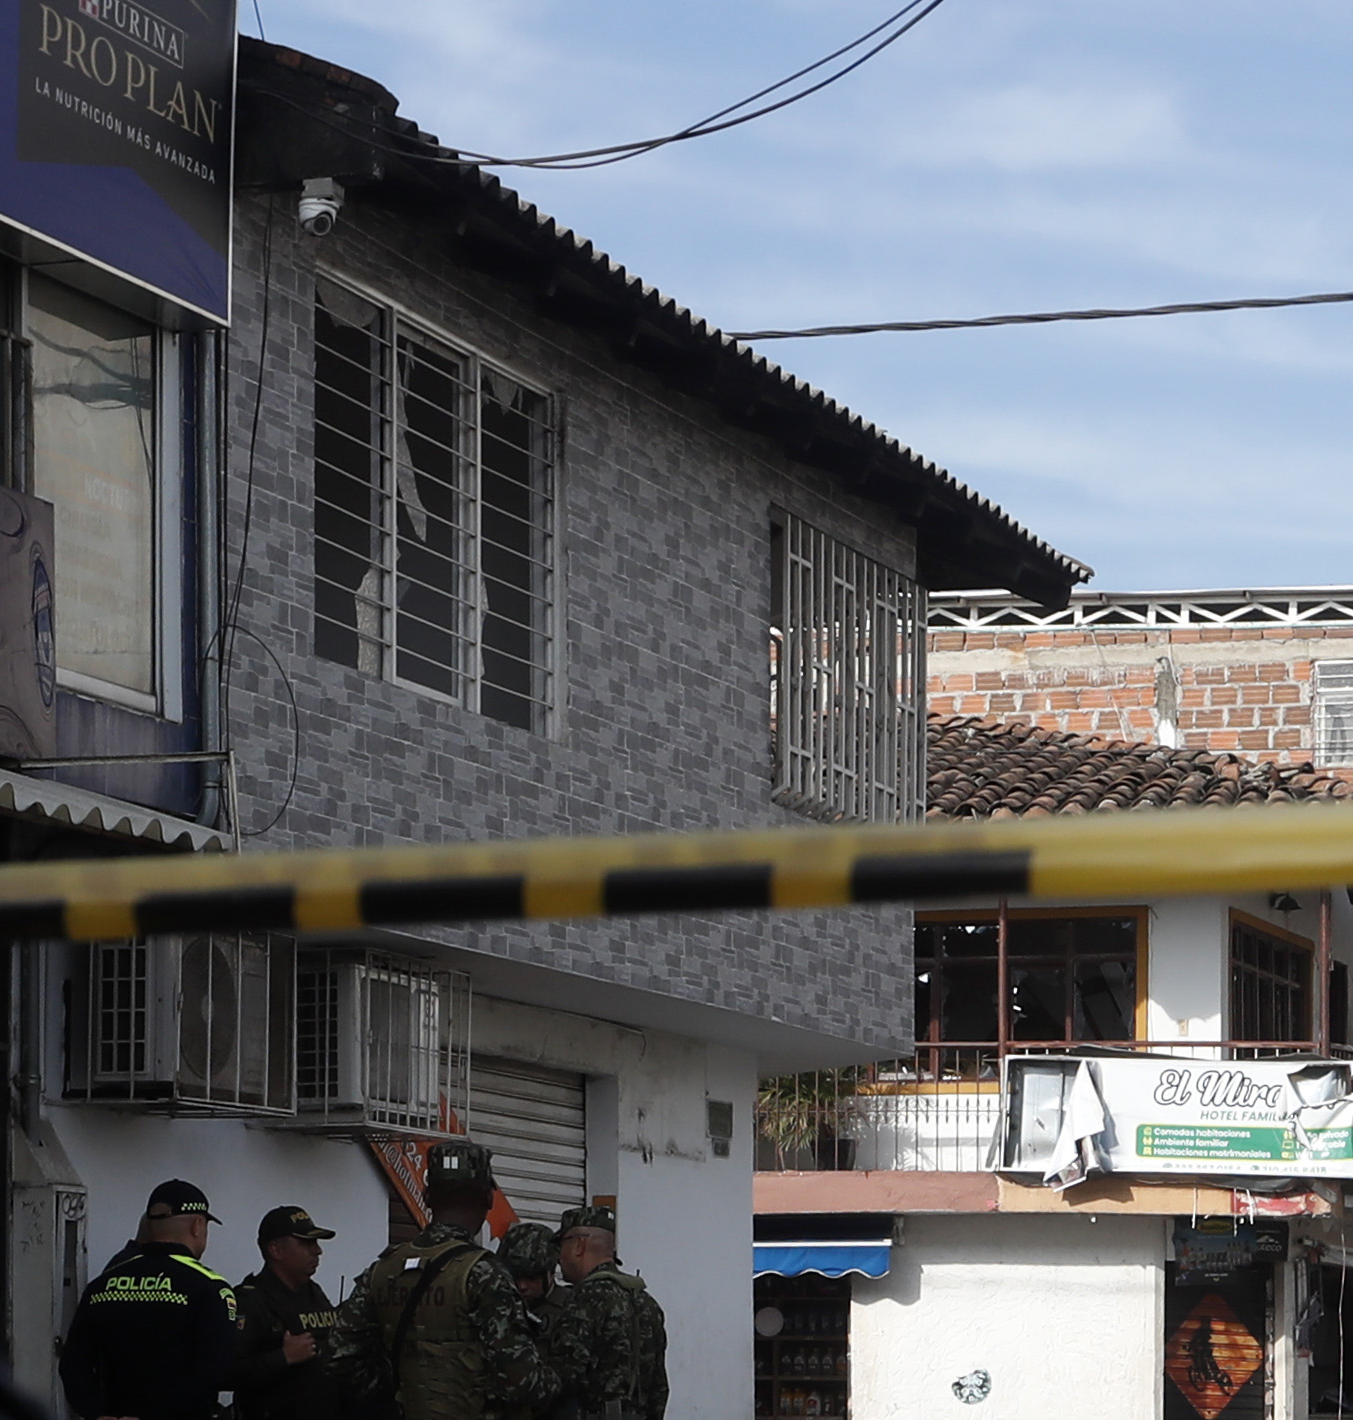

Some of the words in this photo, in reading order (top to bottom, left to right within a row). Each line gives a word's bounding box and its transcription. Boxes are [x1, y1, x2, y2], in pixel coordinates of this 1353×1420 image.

[103, 0, 181, 61] PURINA
[38, 3, 117, 87] PRO
[123, 51, 218, 144] PLAN
[34, 77, 50, 98] LA
[55, 89, 122, 136] NUTRICIÓN
[126, 124, 151, 149] MÁS
[155, 141, 216, 184] AVANZADA
[1154, 1069, 1192, 1106] El
[1200, 1110, 1239, 1121] HOTEL
[1153, 1138, 1194, 1147] Ambiente
[1195, 1138, 1229, 1148] familiar
[1195, 1128, 1251, 1138] habitaciones
[1153, 1147, 1208, 1157] Habitaciones
[1209, 1149, 1272, 1159] matrimoniales
[105, 1272, 172, 1292] POLICÍA
